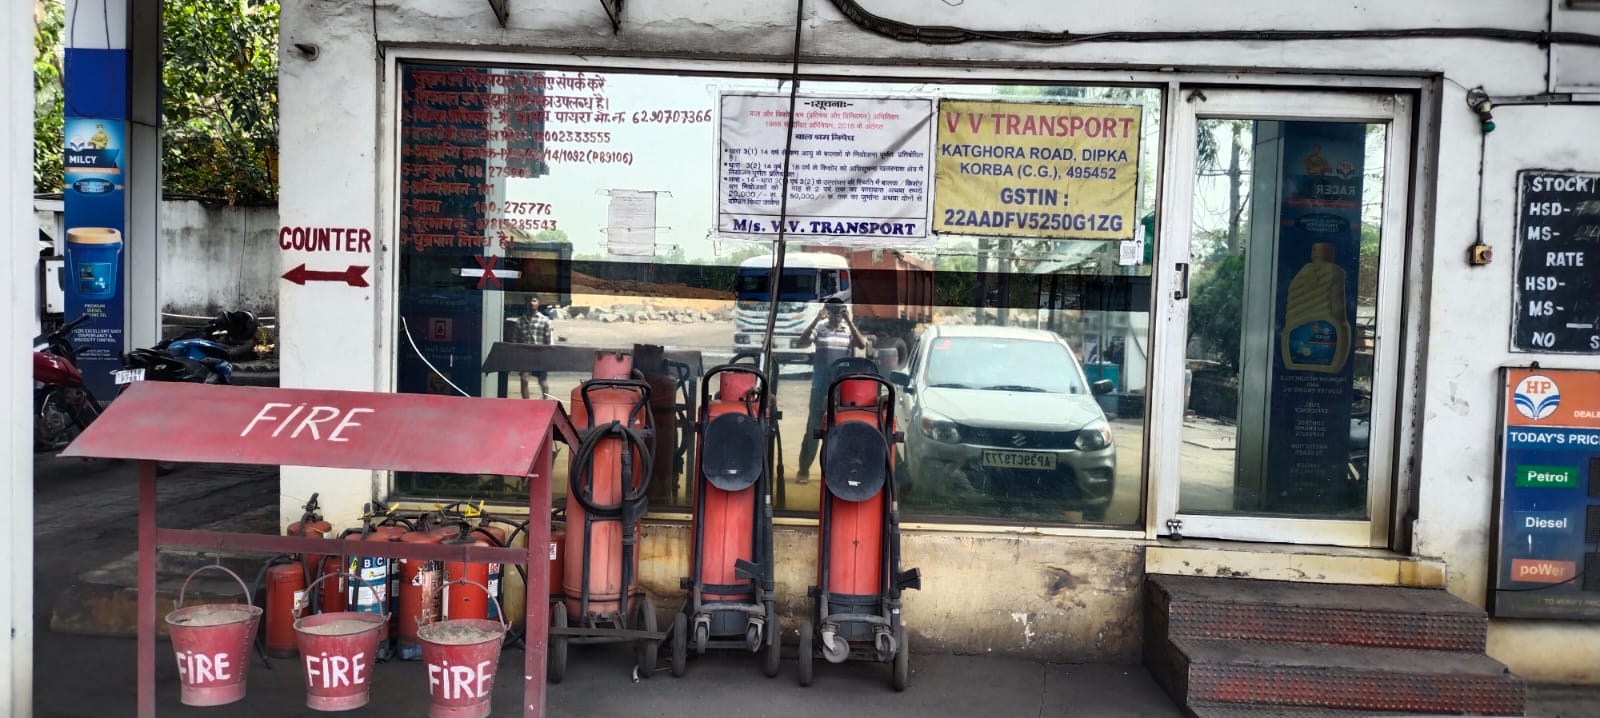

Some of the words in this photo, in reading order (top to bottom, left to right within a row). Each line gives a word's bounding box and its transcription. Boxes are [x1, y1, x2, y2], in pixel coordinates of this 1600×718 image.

[556, 71, 586, 91] संपर्क
[588, 75, 606, 92] करें
[632, 109, 713, 124] 6290707366
[946, 112, 960, 134] V
[968, 113, 984, 134] V
[991, 114, 1134, 138] TRANSPORT
[69, 155, 97, 164] MILCY
[942, 144, 1026, 160] KATGHORA
[1030, 147, 1077, 162] ROAD,
[1082, 148, 1128, 162] DIPKA
[960, 162, 1014, 177] KORBA
[1017, 164, 1062, 180] (C.G.),
[1066, 166, 1116, 180] 495452
[1532, 176, 1590, 192] STOCK
[1000, 188, 1058, 206] GSTIN
[504, 201, 552, 216] 275776
[733, 219, 766, 232] M/s.
[771, 220, 805, 232] V.V.
[810, 222, 916, 235] TRANSPORT
[944, 208, 1123, 232] 22AADFV5250G1ZG
[279, 226, 372, 253] COUNTER
[1546, 252, 1584, 267] RATE
[1532, 332, 1556, 348] NO
[1526, 380, 1552, 394] HP
[1510, 432, 1565, 444] TODAY'S
[1569, 434, 1600, 446] PRIC
[1525, 516, 1568, 529] Diesel
[364, 560, 371, 568] B
[376, 557, 383, 566] C
